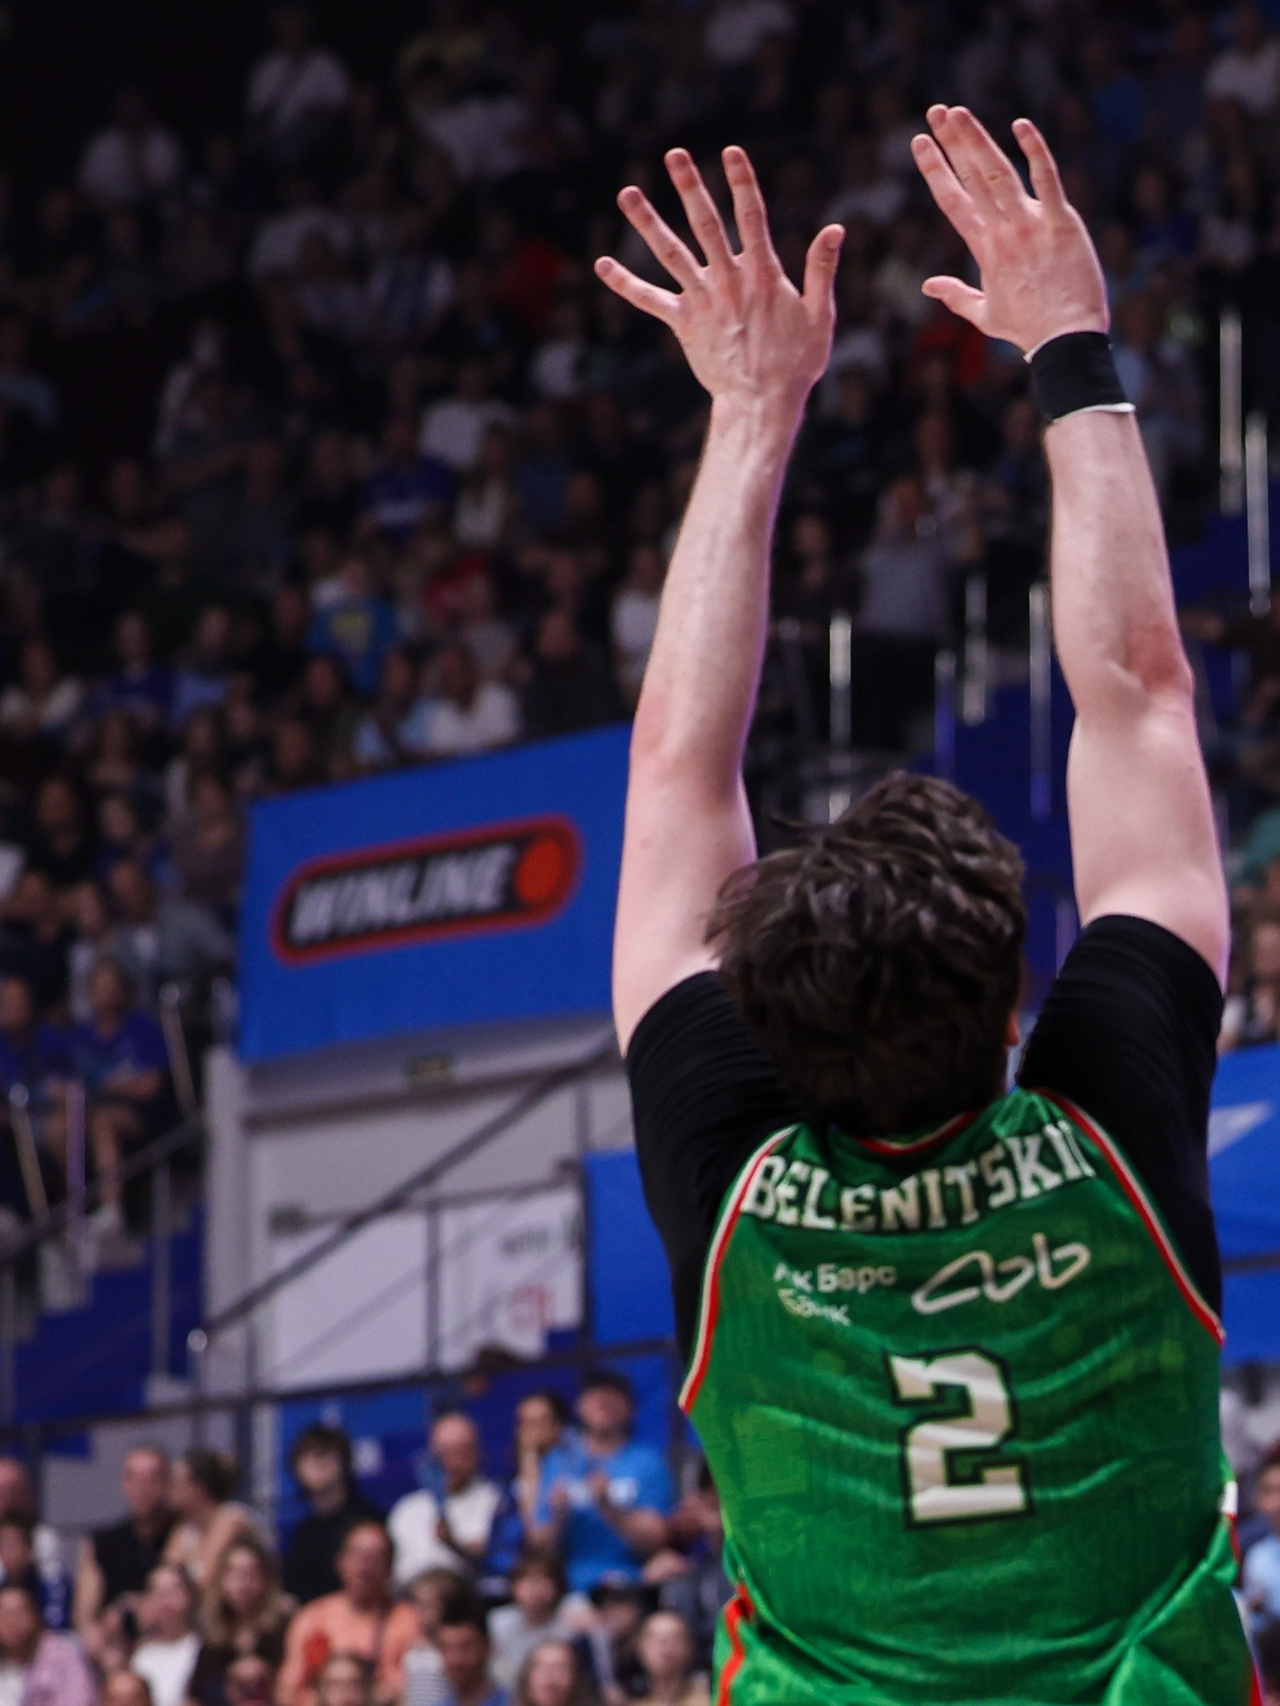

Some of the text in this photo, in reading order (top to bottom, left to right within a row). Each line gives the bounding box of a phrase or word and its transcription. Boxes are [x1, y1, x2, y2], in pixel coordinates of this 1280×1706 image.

[288, 840, 518, 949] WINLINE
[816, 1263, 898, 1296] Барс
[886, 1347, 1030, 1525] 2
